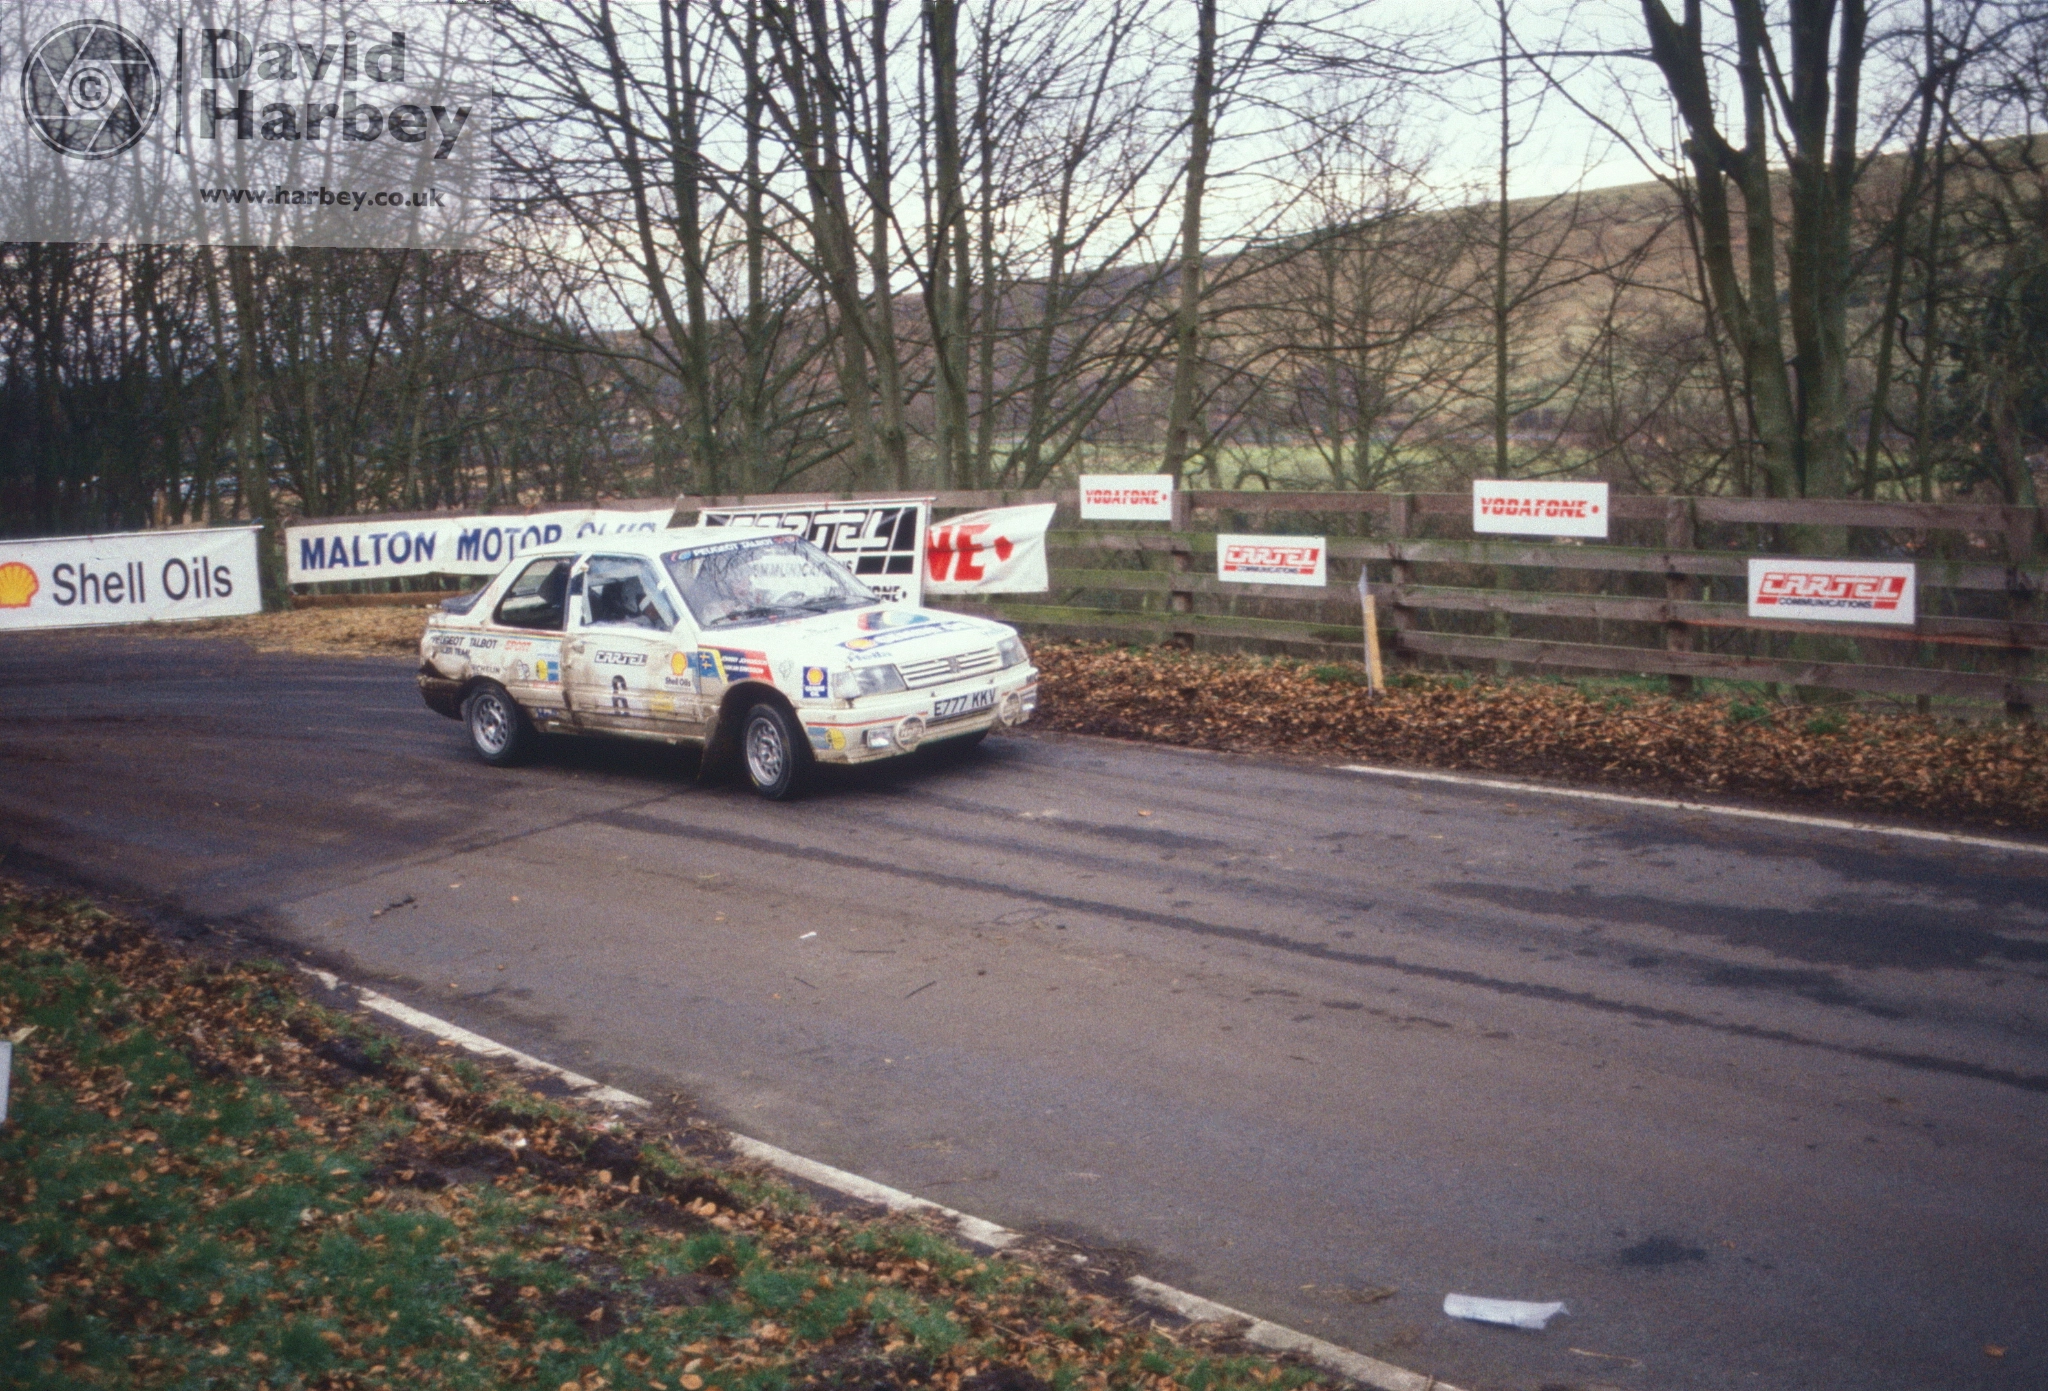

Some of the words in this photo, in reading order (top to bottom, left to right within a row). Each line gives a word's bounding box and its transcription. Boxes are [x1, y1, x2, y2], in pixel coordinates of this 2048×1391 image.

[1086, 490, 1159, 505] VODAFONE
[1480, 497, 1587, 518] VODAFONE
[300, 530, 437, 571] MALTON
[1227, 546, 1317, 567] CARTEL
[52, 562, 145, 606] Shell
[162, 556, 233, 601] Oils
[1761, 573, 1902, 600] CARTEL
[1779, 597, 1873, 609] COMMUNICATIONS
[469, 638, 498, 649] TALBOT
[595, 650, 648, 666] CARTEL
[665, 676, 678, 685] Shell
[680, 679, 691, 687] Oils
[934, 696, 967, 717] E777
[971, 688, 996, 707] KKV
